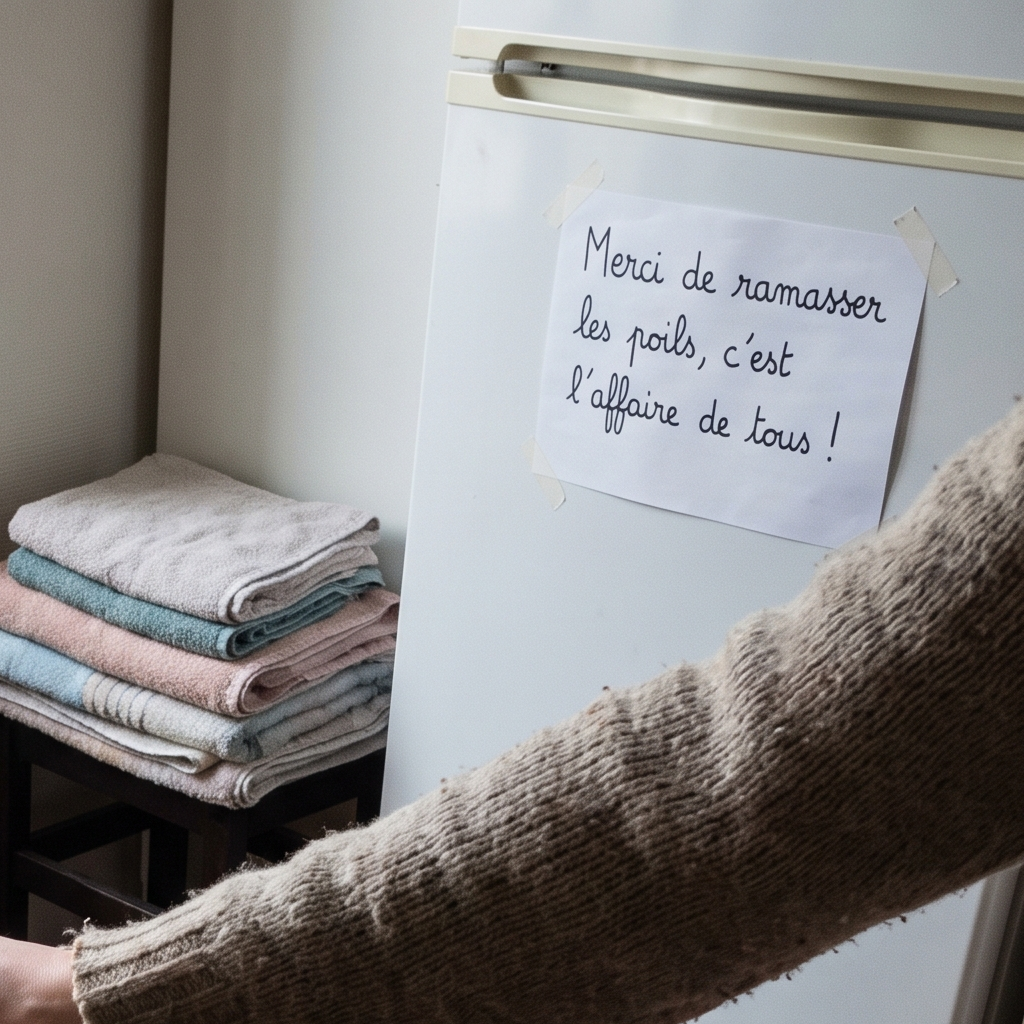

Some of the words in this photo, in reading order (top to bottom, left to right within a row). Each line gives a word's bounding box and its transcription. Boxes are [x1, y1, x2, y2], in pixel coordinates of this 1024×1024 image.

[584, 226, 664, 284] Merci
[682, 251, 717, 293] de
[731, 274, 887, 323] ramasser
[573, 294, 611, 342] les
[626, 314, 706, 370] poils,
[723, 332, 794, 377] c'est
[566, 364, 680, 435] l'affaire
[698, 399, 731, 438] de
[743, 405, 810, 455] tous
[826, 411, 841, 463] !
